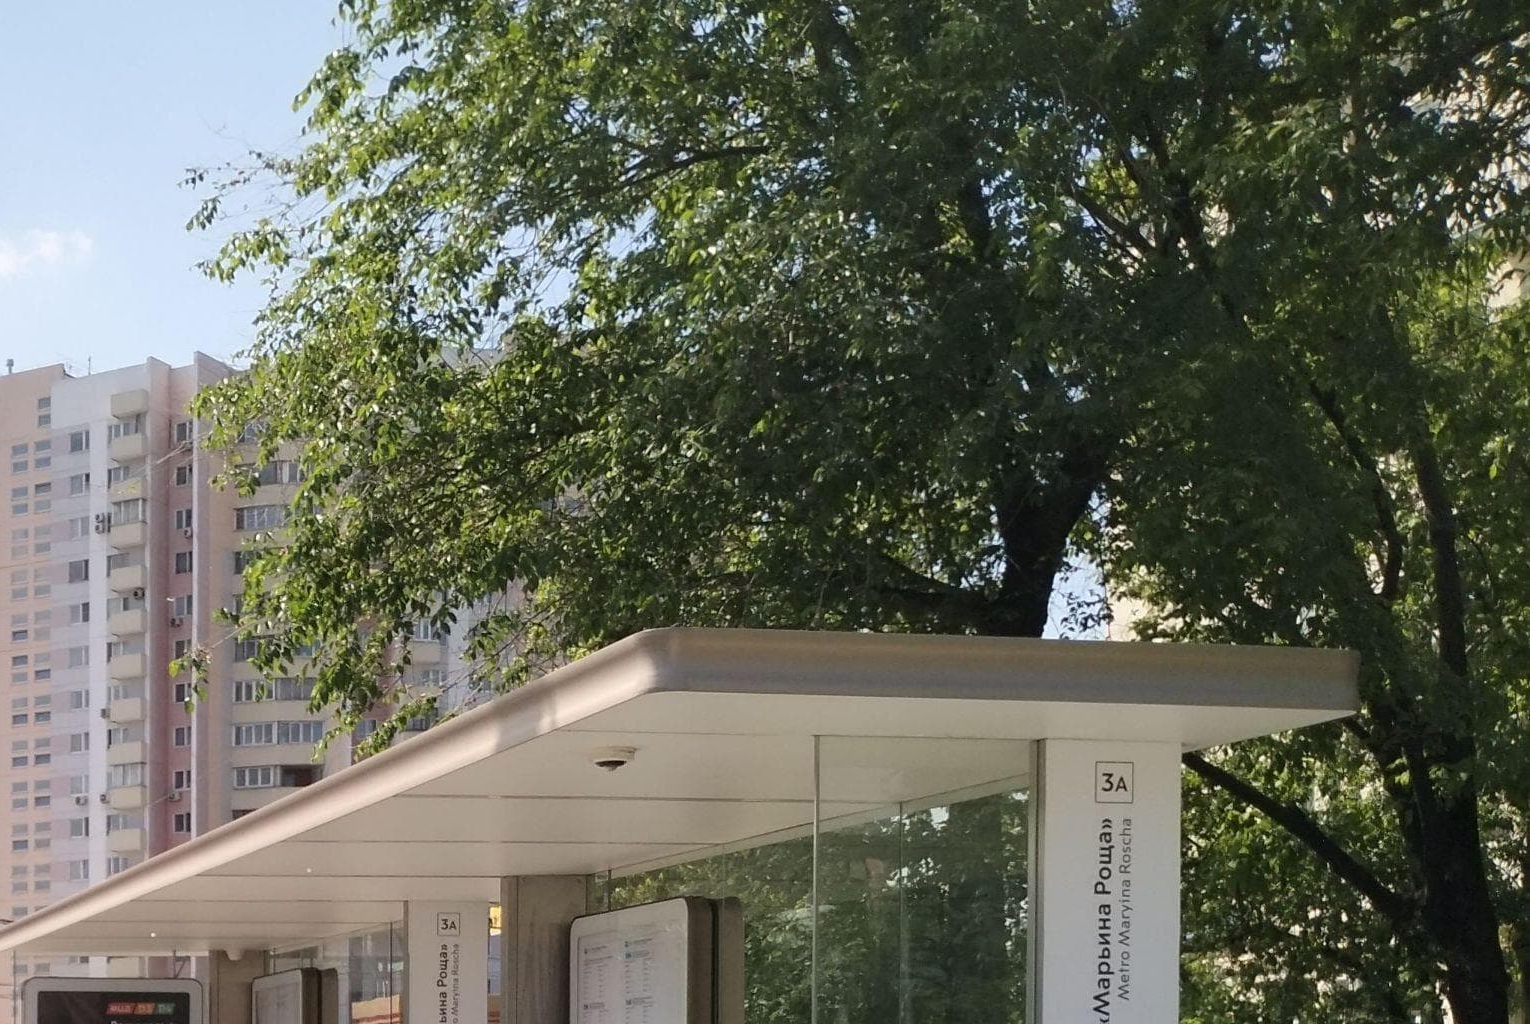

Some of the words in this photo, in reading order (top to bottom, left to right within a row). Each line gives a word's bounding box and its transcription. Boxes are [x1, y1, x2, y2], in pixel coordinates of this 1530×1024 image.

[1100, 771, 1129, 793] 3А
[1093, 817, 1115, 897] Роща»
[1118, 817, 1133, 875] Roscha
[440, 918, 458, 931] 3А
[1118, 878, 1134, 947] Maryina
[437, 944, 449, 988] Роща»
[1118, 949, 1131, 1001] Metro
